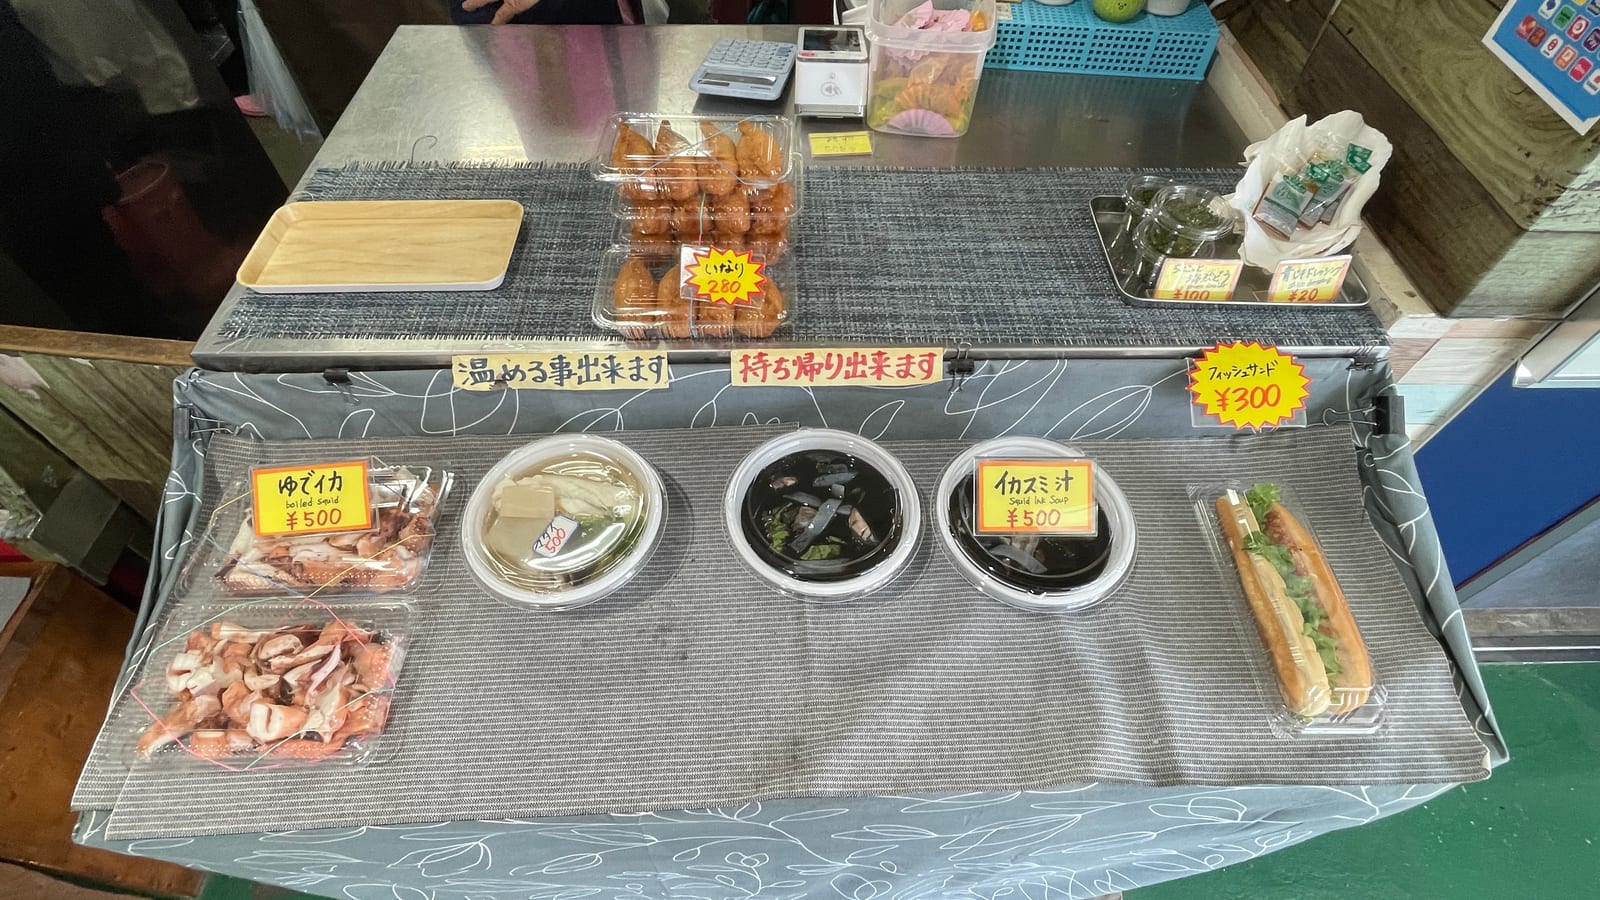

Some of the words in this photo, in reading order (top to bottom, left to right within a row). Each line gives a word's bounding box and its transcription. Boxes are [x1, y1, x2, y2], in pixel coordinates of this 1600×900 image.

[706, 260, 744, 279] いなり
[707, 279, 742, 294] 280
[1172, 287, 1210, 300] ¥100
[1287, 287, 1319, 302] ¥20
[457, 354, 665, 387] 温める事出来ます
[738, 350, 938, 383] 持ち帰り出来ます
[1208, 360, 1279, 380] フィッシュサンド
[1214, 383, 1281, 412] ¥300
[278, 469, 343, 497] ゆでイカ
[993, 469, 1075, 496] イカスミ汁
[285, 497, 313, 509] boiled
[317, 496, 340, 506] squid
[1008, 496, 1031, 506] Squid
[1048, 495, 1070, 505] Soup
[285, 508, 342, 530] ¥500
[1006, 507, 1061, 528] ¥500
[545, 527, 566, 553] 500
